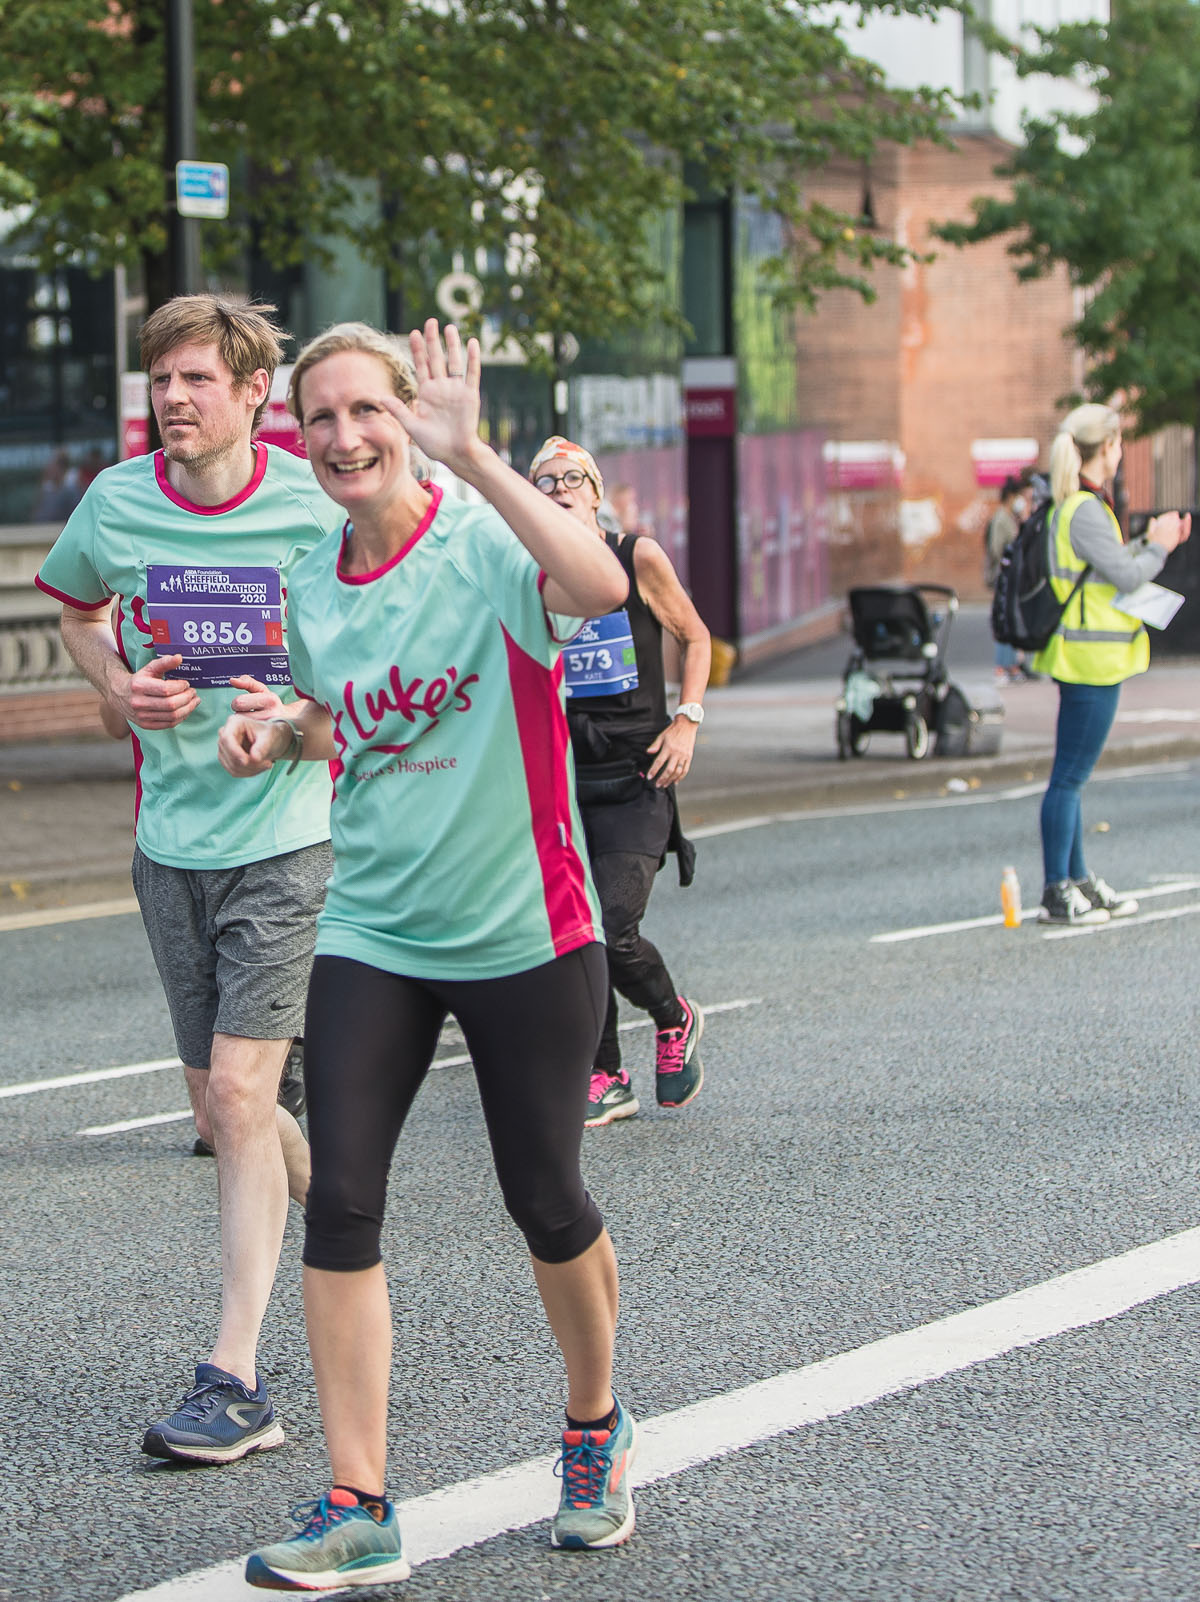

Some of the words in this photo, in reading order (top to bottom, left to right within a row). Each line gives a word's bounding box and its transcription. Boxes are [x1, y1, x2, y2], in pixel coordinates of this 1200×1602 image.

[184, 575, 228, 583] SHEFFIELD
[185, 584, 208, 592] HALF
[209, 584, 266, 593] MARATHON
[240, 594, 266, 603] 2020
[261, 610, 271, 619] M
[183, 620, 253, 645] 8856
[191, 646, 249, 655] MATTHEW
[569, 649, 613, 672] 573
[265, 673, 291, 682] 8856
[397, 756, 458, 775] Hospice
